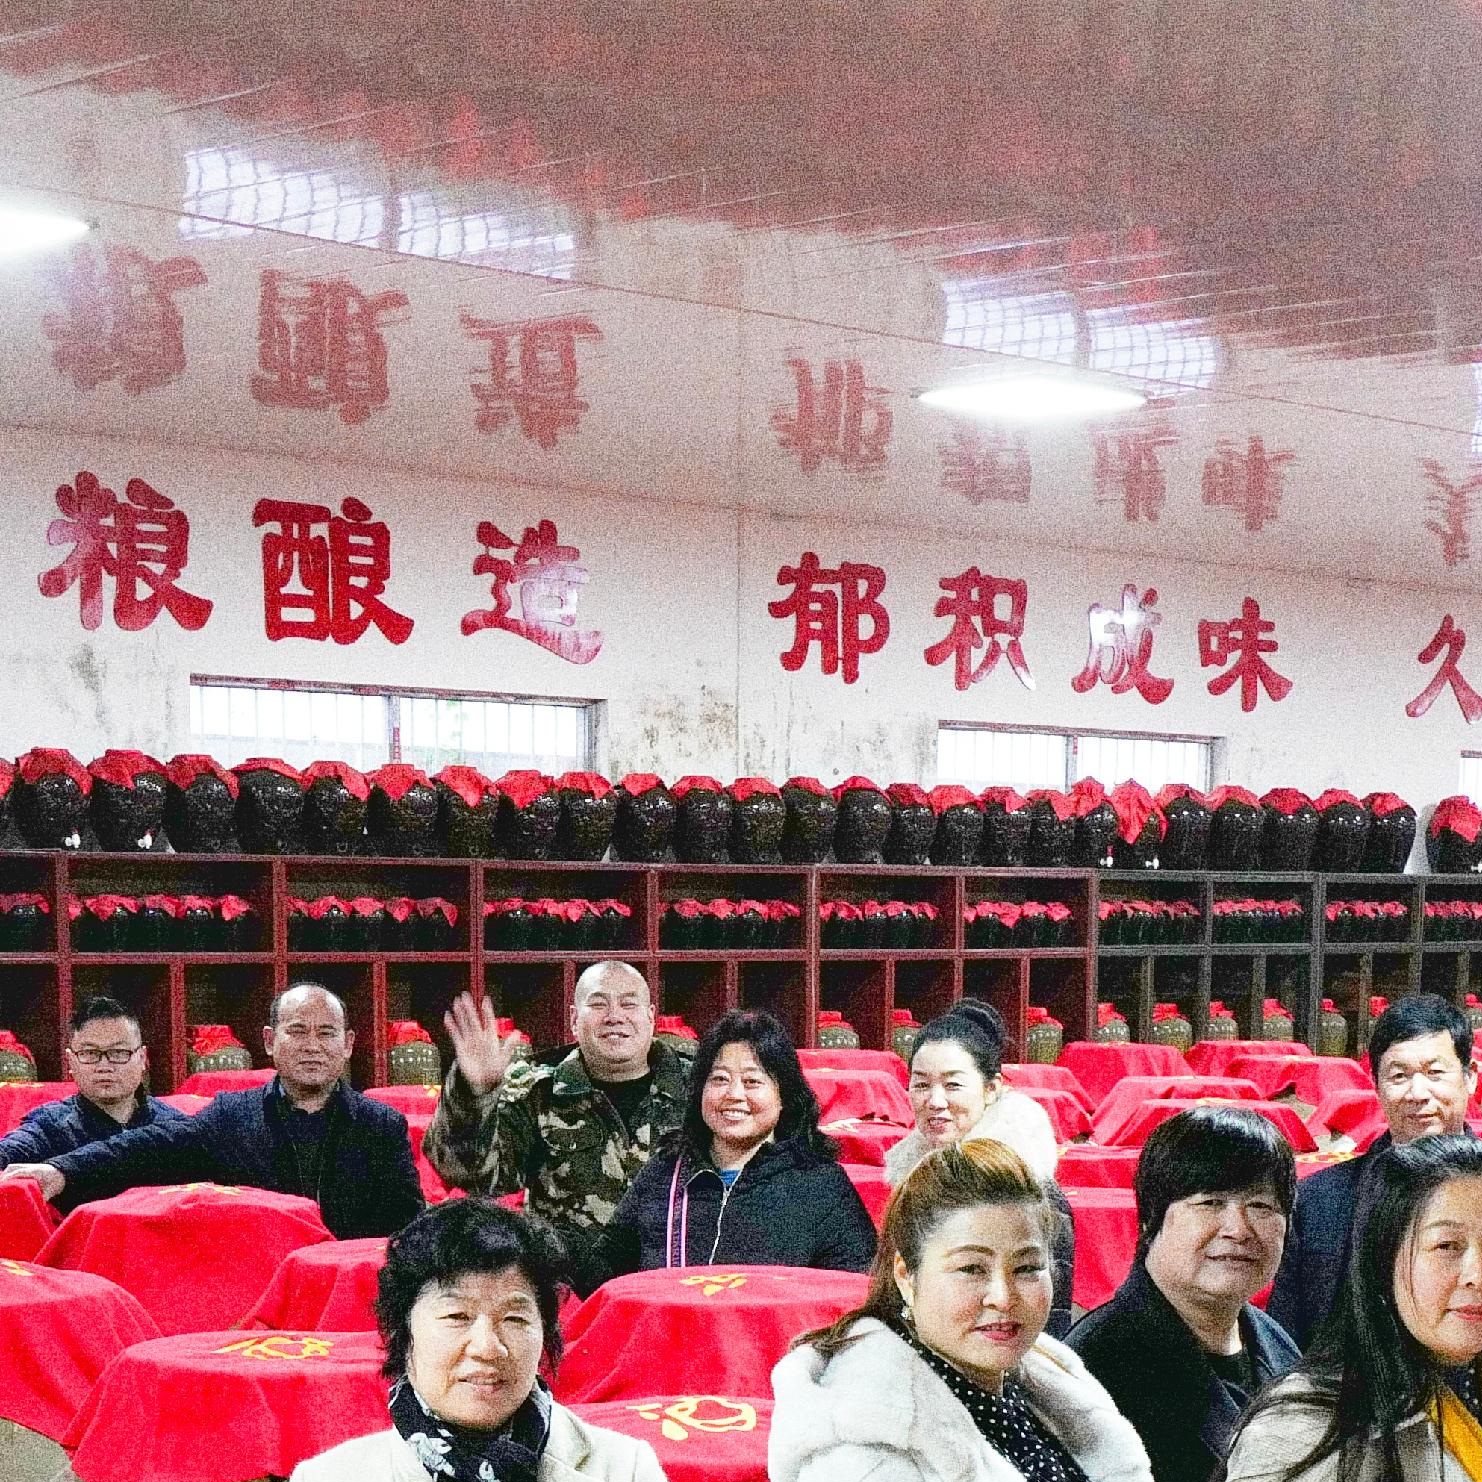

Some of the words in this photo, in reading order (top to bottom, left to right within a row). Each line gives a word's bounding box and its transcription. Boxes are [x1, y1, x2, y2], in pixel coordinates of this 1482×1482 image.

[38, 471, 604, 664] 粮酿造
[768, 551, 1293, 712] 郁积成味
